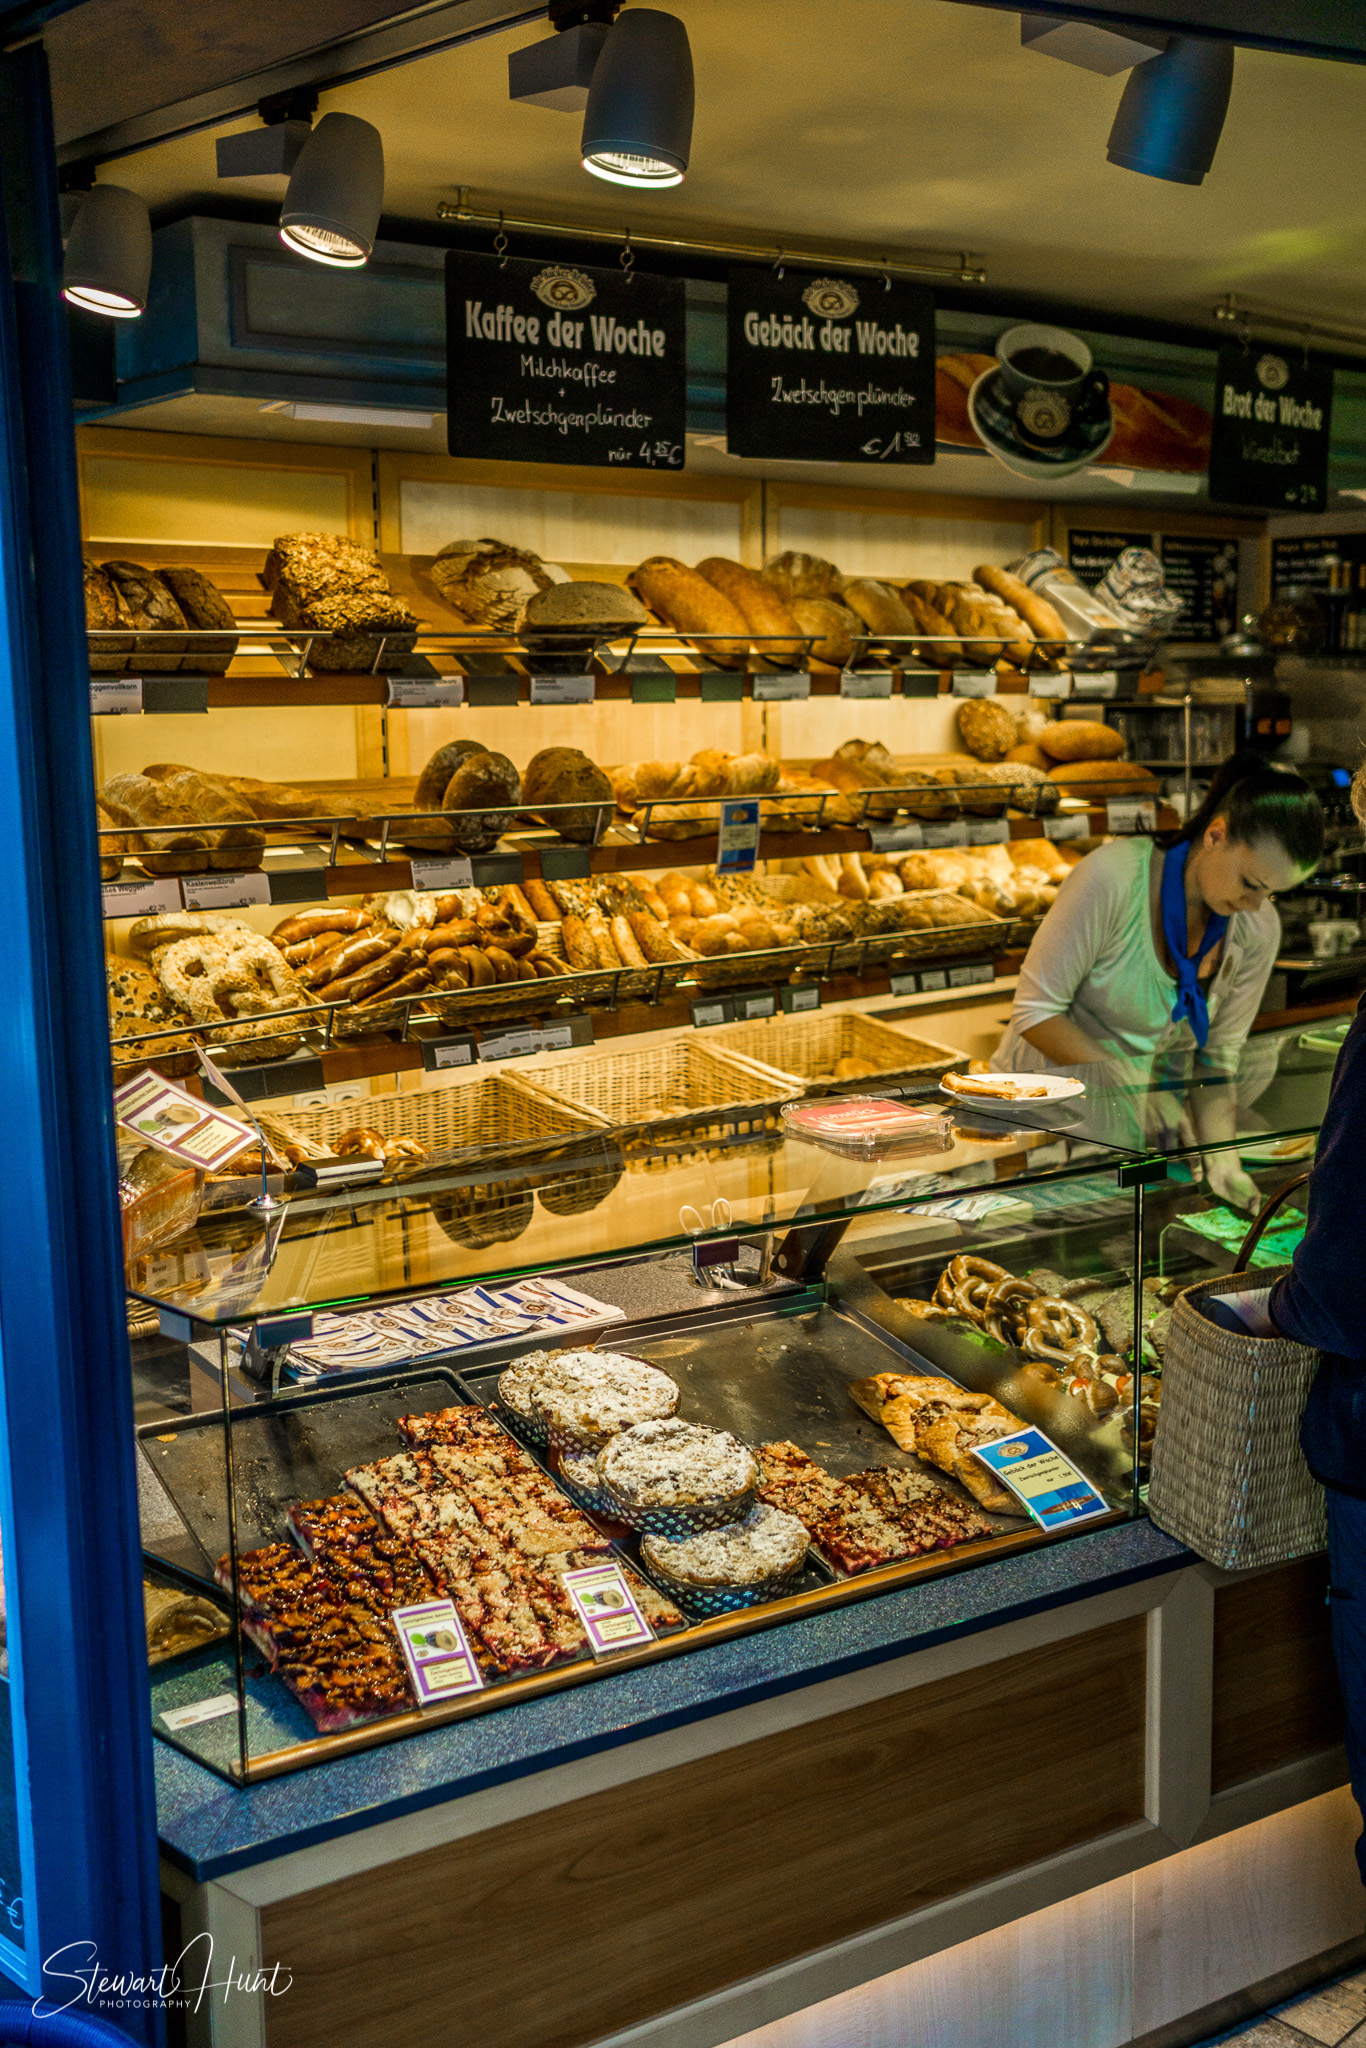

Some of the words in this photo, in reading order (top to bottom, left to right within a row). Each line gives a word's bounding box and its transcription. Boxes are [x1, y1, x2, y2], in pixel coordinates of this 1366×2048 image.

[465, 300, 540, 345] Kaffee
[546, 311, 585, 349] der
[589, 315, 666, 357] Woche
[744, 312, 816, 350] Gebäck
[819, 319, 852, 352] der
[855, 320, 920, 357] Woche
[1223, 384, 1252, 419] Brot
[1255, 391, 1277, 423] der
[1279, 395, 1323, 430] Woche
[89, 682, 138, 692] oggenvollkorn
